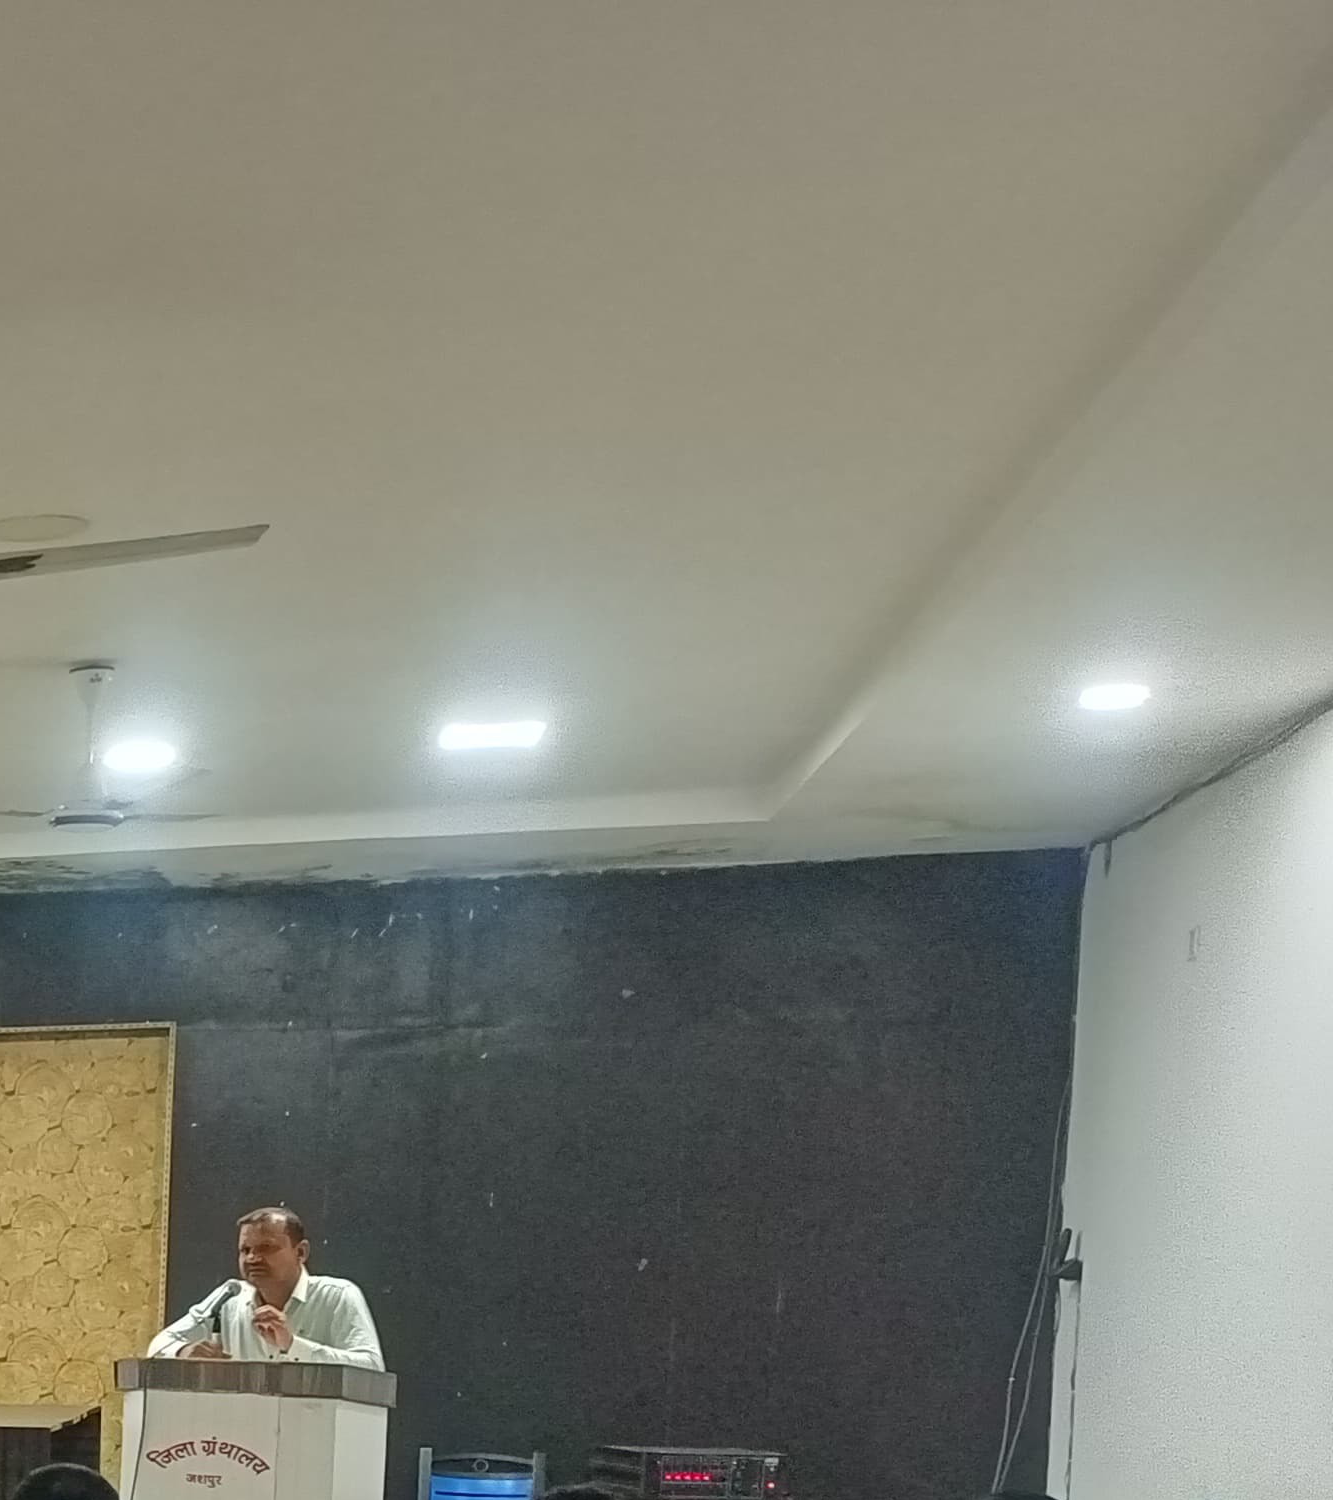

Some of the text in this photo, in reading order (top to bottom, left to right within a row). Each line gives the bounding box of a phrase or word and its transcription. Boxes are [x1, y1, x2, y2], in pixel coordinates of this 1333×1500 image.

[146, 1436, 271, 1475] जिला ग्रंथालय
[185, 1472, 223, 1488] जशपुर
